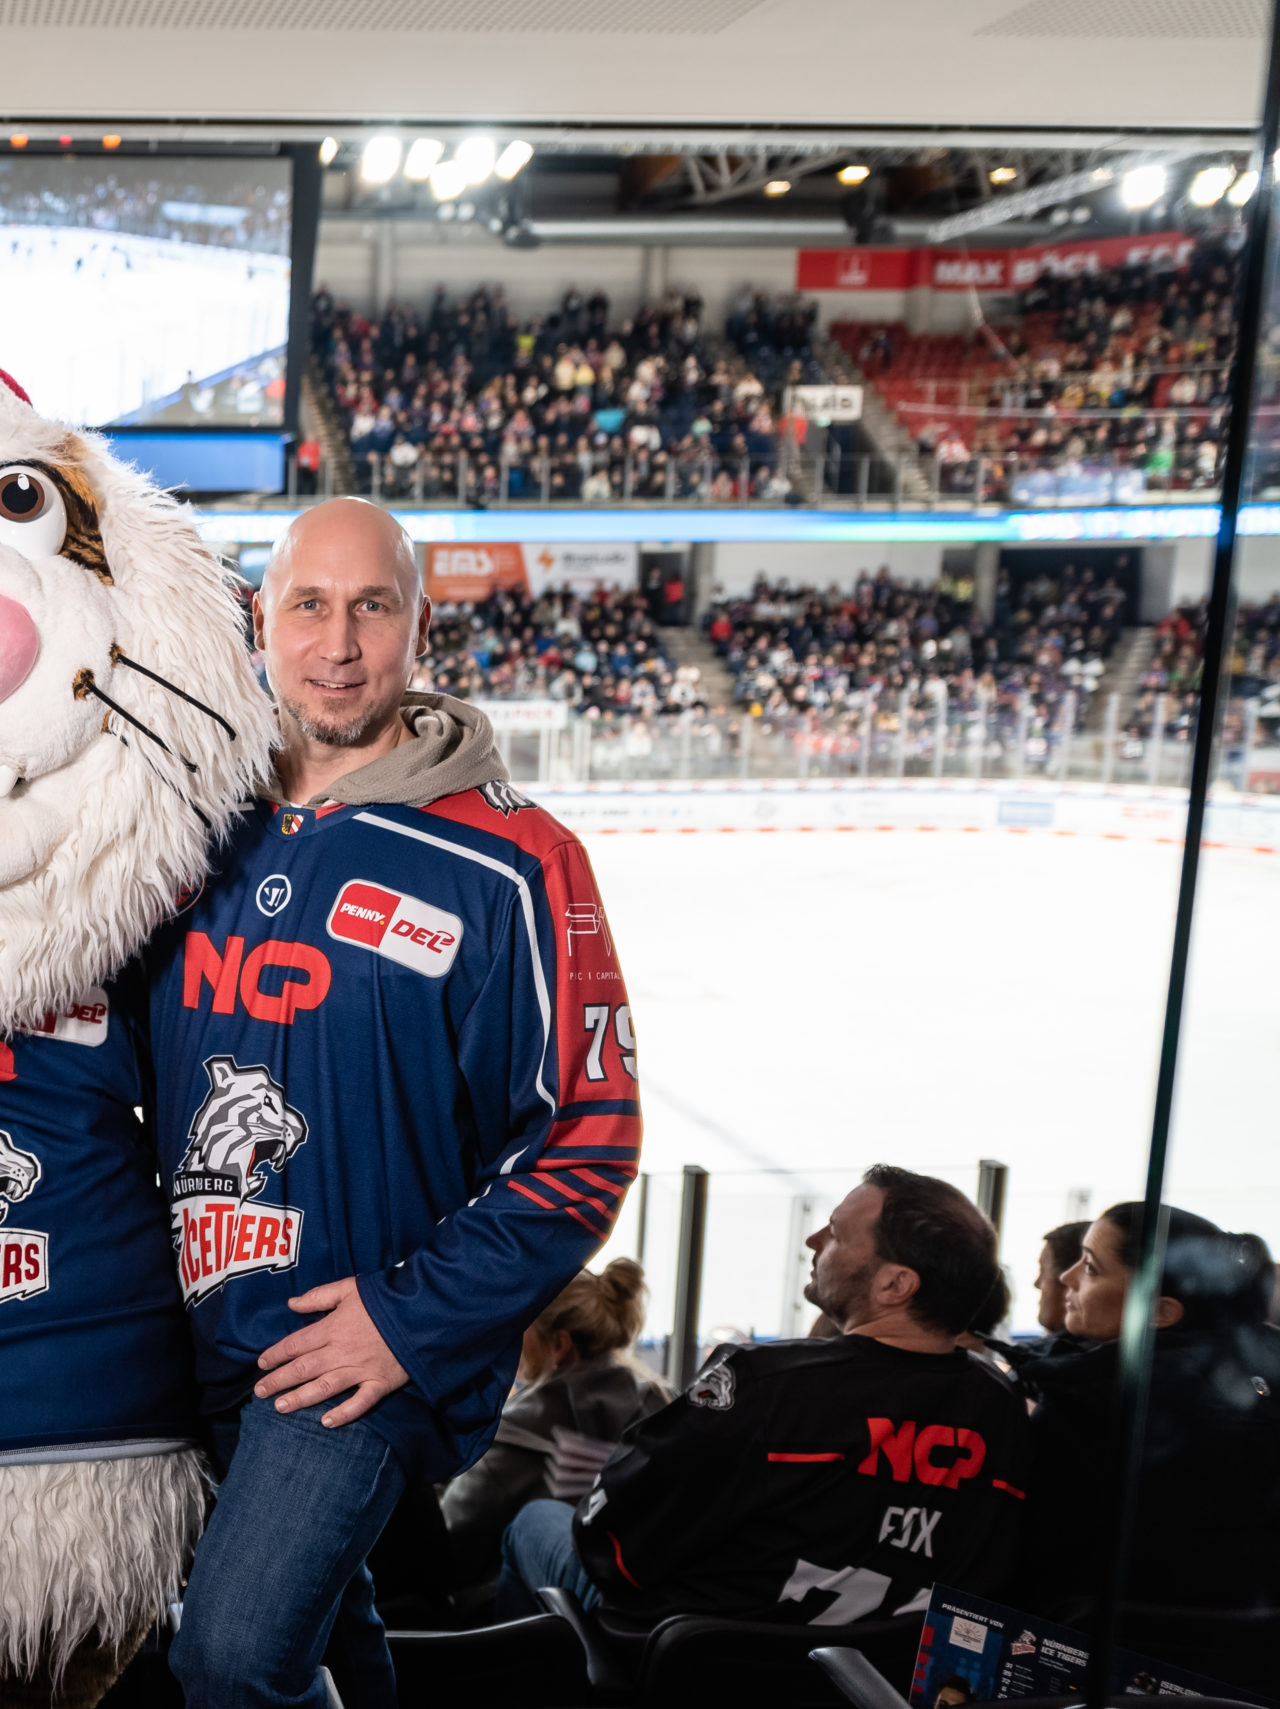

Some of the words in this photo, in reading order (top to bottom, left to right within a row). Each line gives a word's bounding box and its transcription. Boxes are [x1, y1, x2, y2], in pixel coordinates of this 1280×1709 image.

[933, 259, 1005, 286] MAX
[390, 918, 456, 954] DEL
[183, 930, 332, 1026] NCP
[583, 1002, 639, 1084] 79
[856, 1416, 987, 1490] NCP
